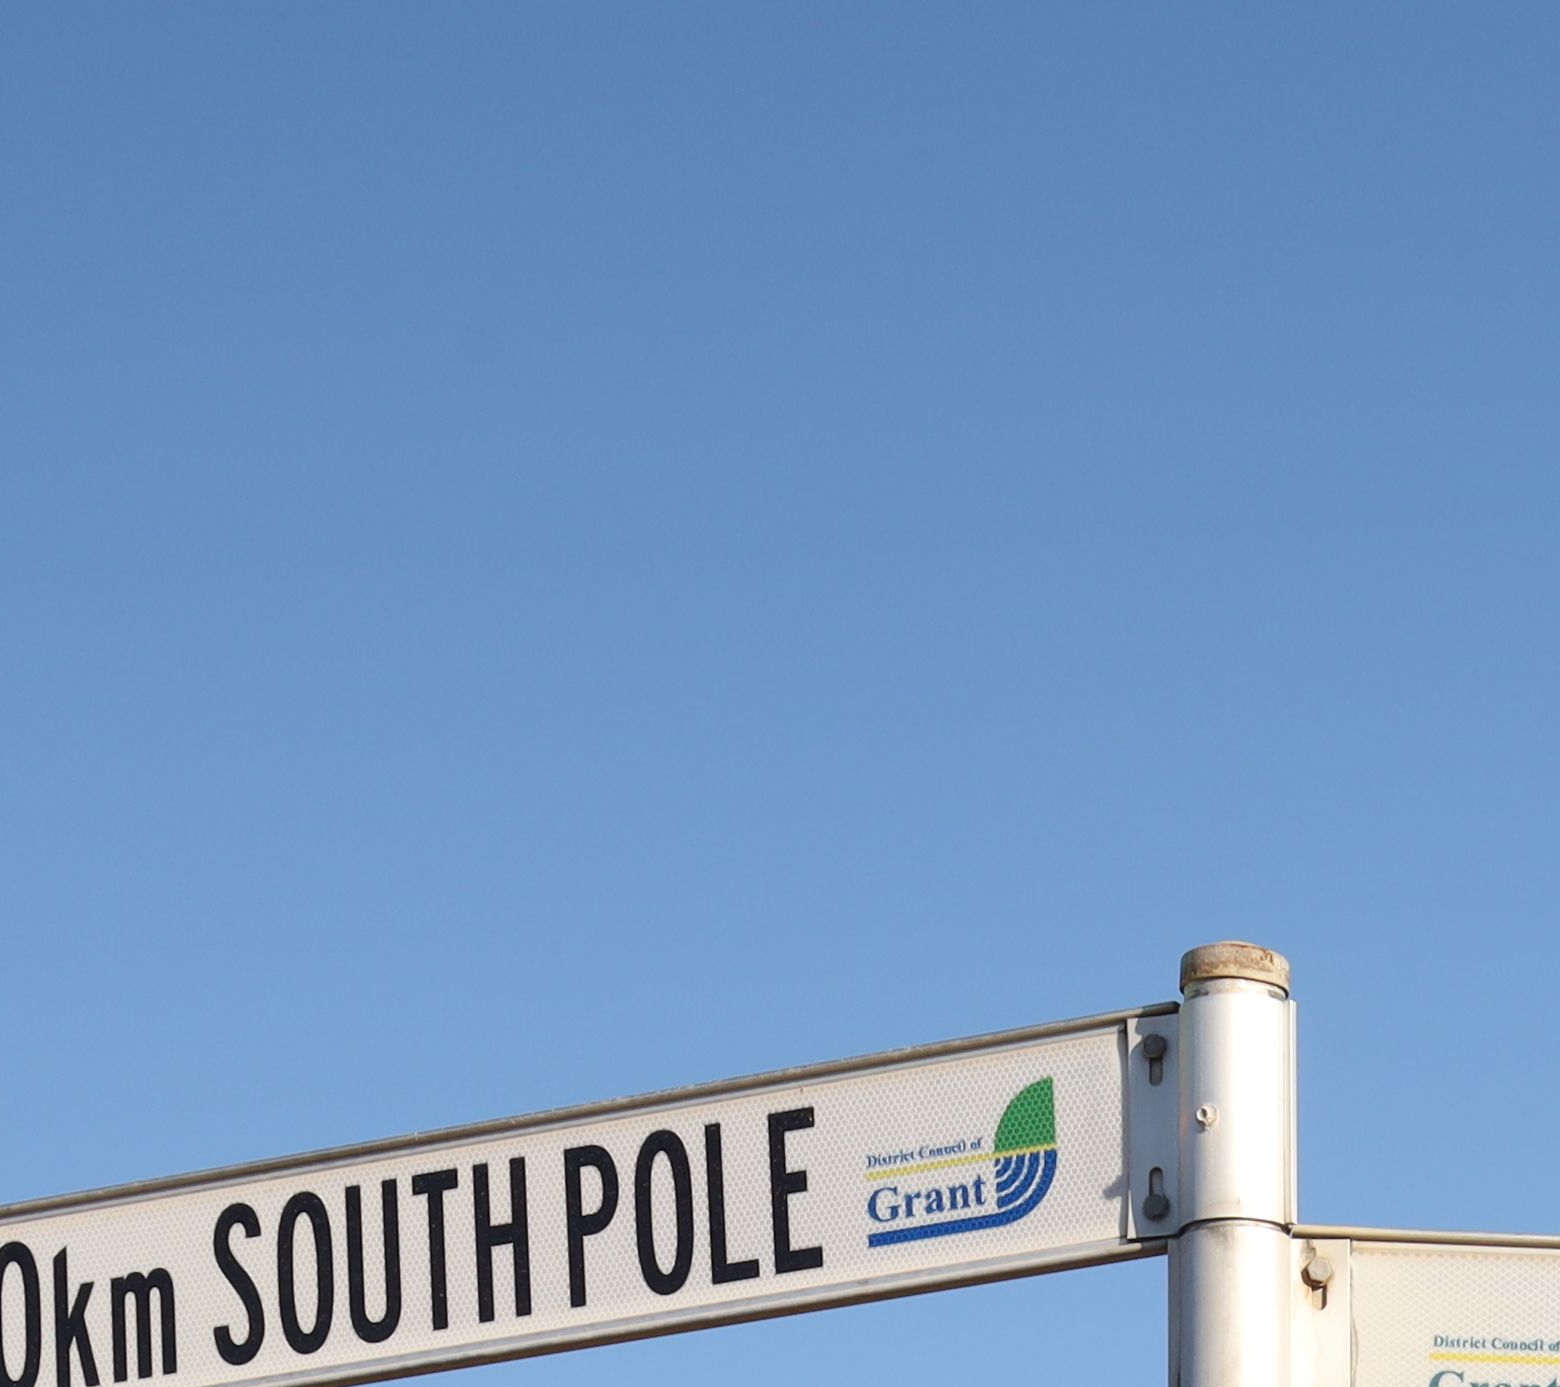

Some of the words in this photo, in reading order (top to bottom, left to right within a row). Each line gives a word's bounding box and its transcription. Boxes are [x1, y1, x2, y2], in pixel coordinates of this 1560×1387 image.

[867, 1151, 915, 1168] District
[919, 1140, 966, 1159] Council
[970, 1137, 983, 1150] of
[867, 1174, 986, 1222] Grant
[213, 1156, 532, 1366] SOUTH
[563, 1106, 824, 1309] POLE
[1432, 1335, 1487, 1349] District
[1490, 1337, 1544, 1351] Council
